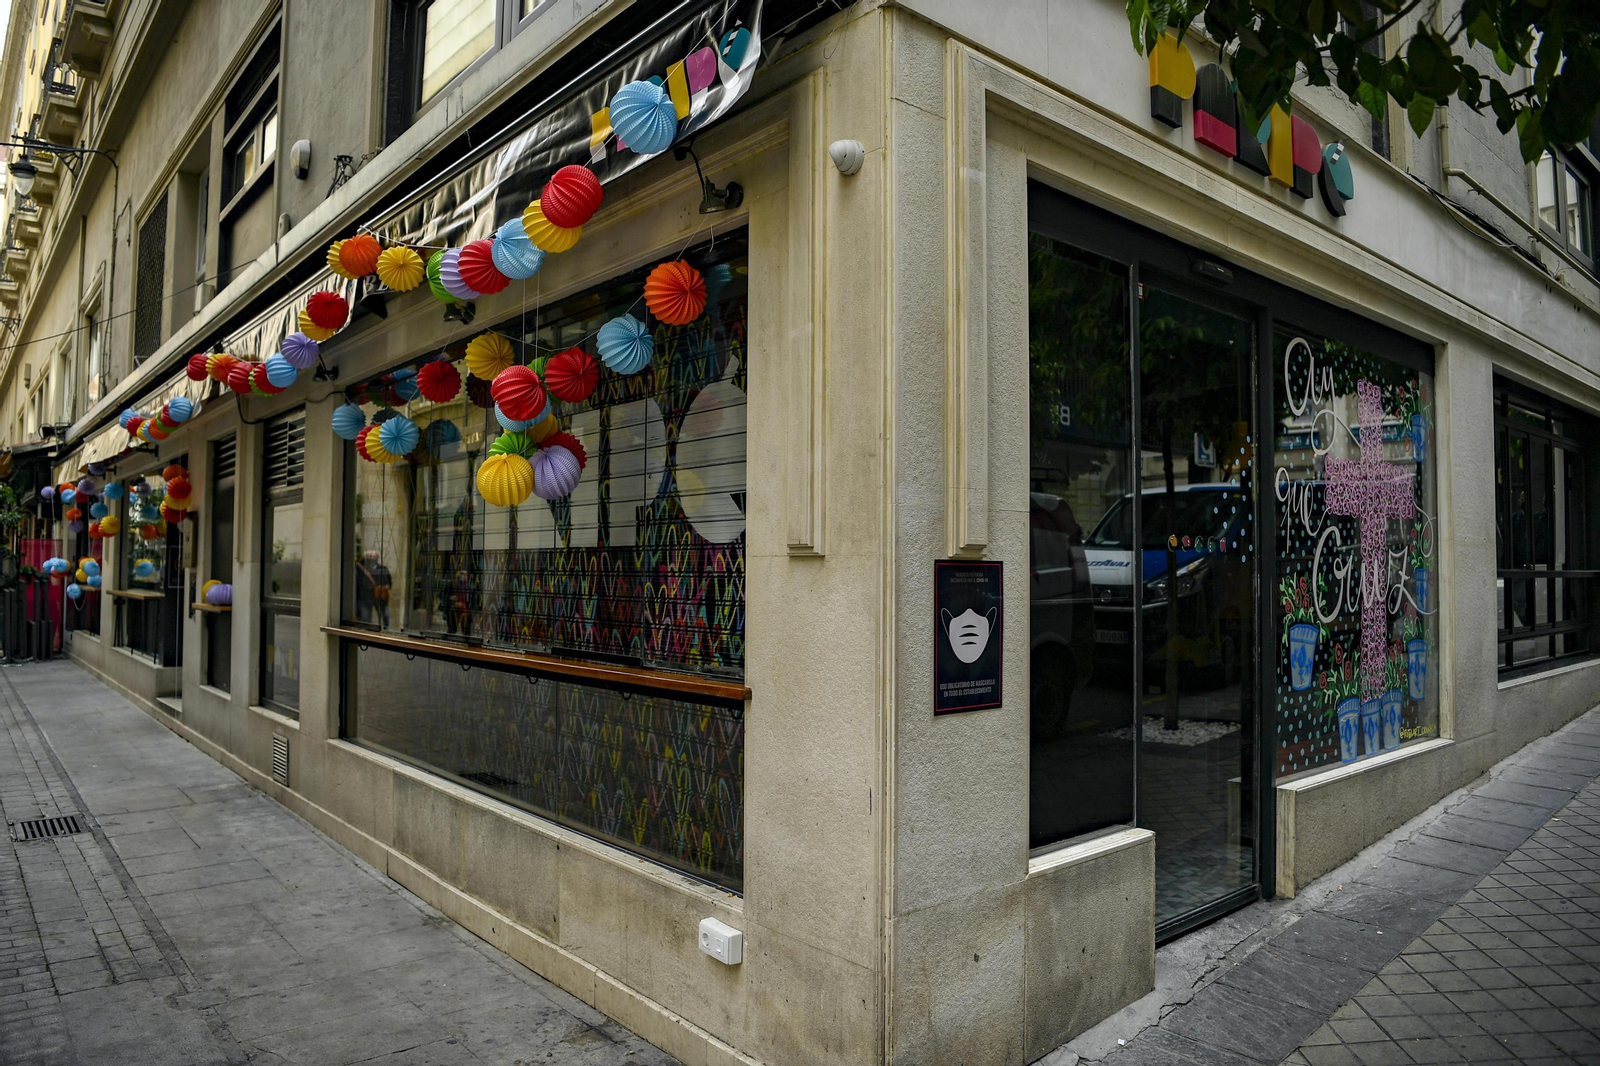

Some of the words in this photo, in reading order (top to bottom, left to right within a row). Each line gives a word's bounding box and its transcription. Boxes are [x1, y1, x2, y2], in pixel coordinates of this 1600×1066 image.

[948, 681, 970, 689] OBLIGATORIO
[976, 679, 996, 687] MASCARILLA
[949, 689, 958, 697] TODO
[963, 686, 992, 695] ESTABLECIMIENTO
